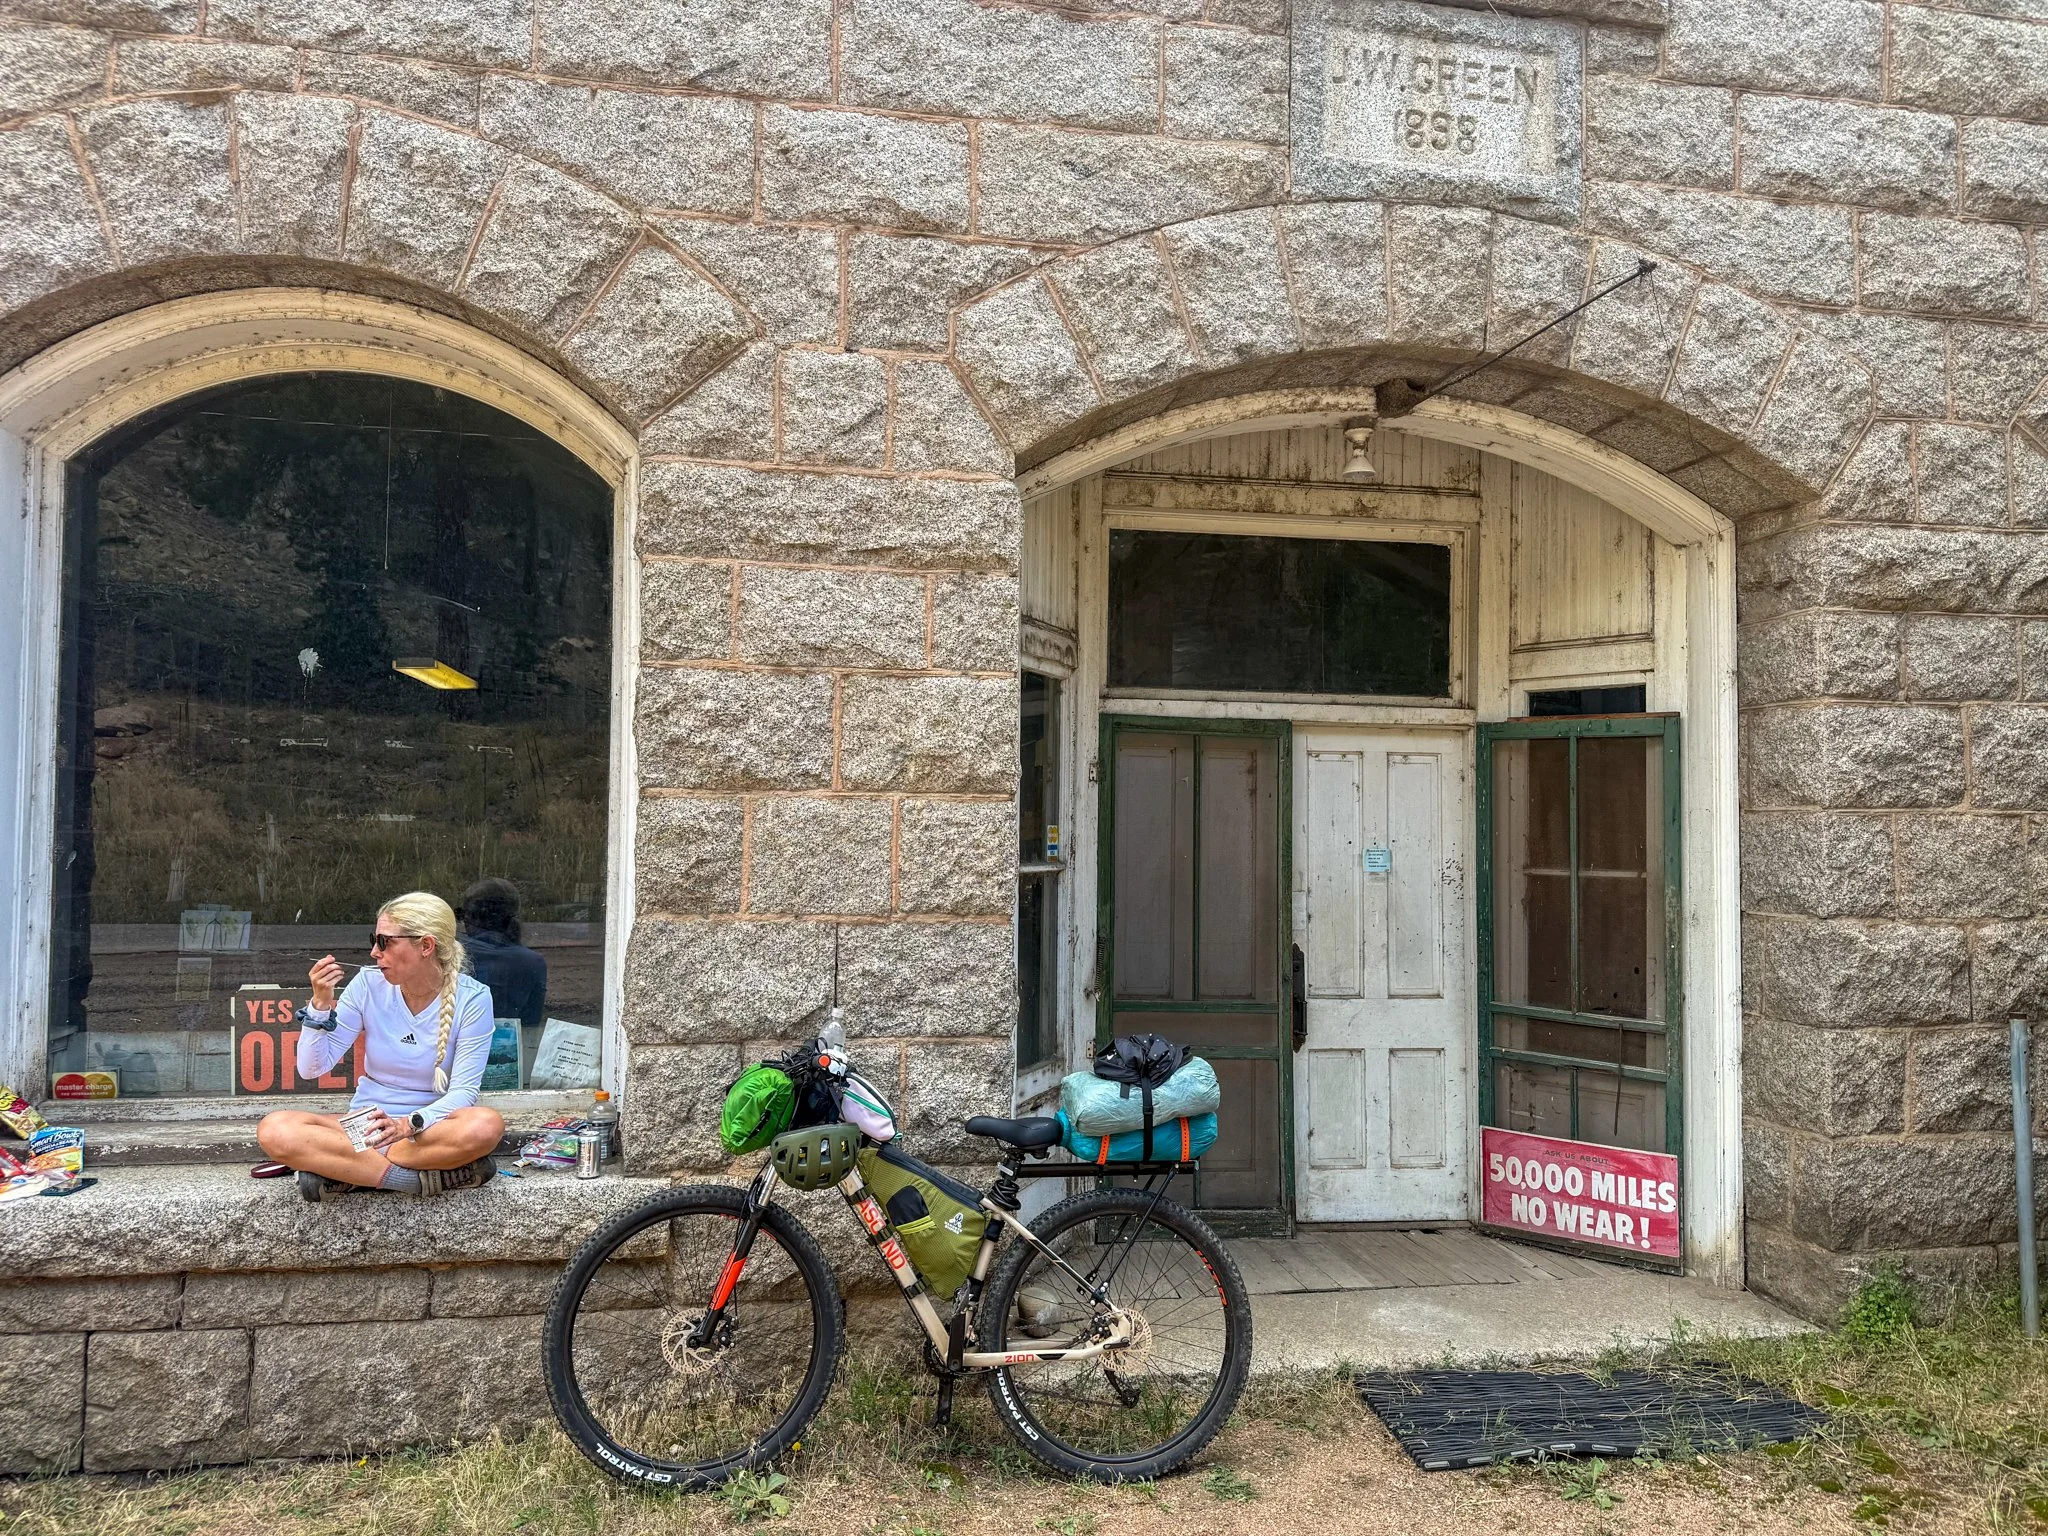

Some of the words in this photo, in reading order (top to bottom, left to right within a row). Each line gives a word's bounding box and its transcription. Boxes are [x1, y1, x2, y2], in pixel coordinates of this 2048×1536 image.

[246, 1000, 293, 1024] YES
[85, 1083, 113, 1091] charge
[30, 1134, 53, 1150] Smart
[54, 1130, 80, 1142] Bowls
[1544, 1150, 1561, 1158] ASK
[1564, 1152, 1576, 1160] US
[1580, 1155, 1609, 1165] ABOUT
[1489, 1152, 1584, 1197] 50,000
[1591, 1170, 1677, 1213] MILES
[1511, 1193, 1547, 1227] NO
[858, 1199, 907, 1270] ASCND
[1005, 1353, 1035, 1363] ZION
[997, 1368, 1022, 1420] PATROL
[1018, 1420, 1040, 1441] CST
[596, 1442, 645, 1478] PATROL
[643, 1471, 672, 1483] CST
